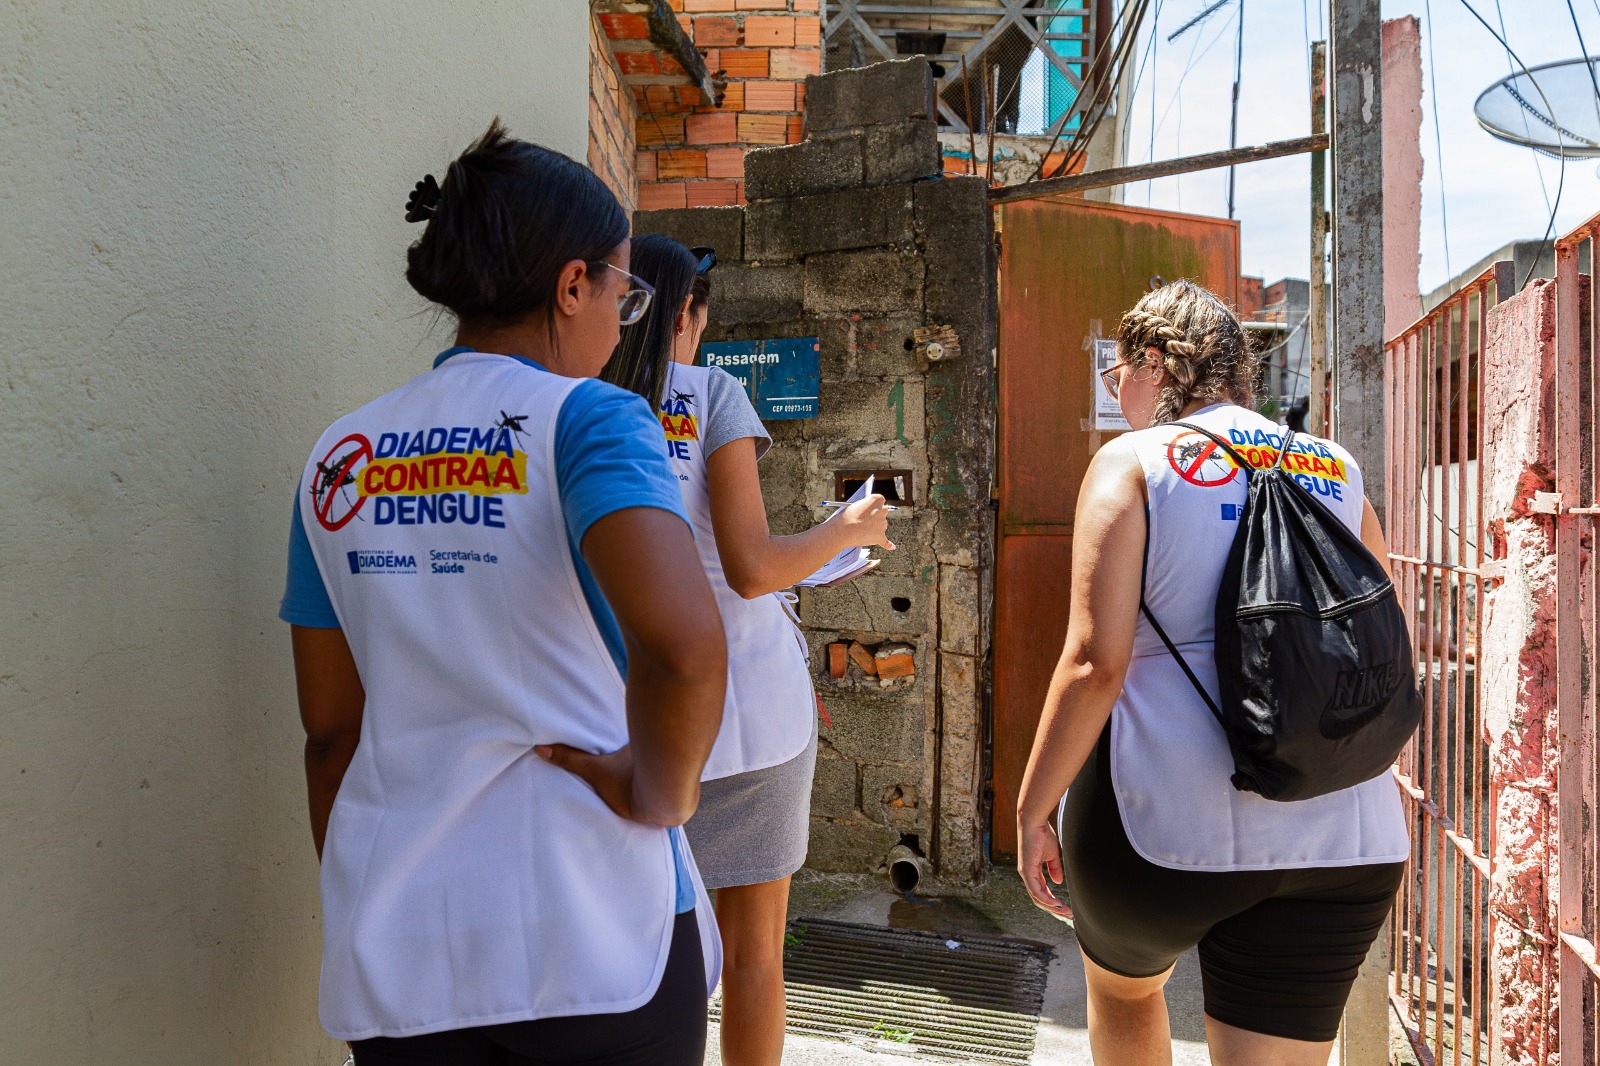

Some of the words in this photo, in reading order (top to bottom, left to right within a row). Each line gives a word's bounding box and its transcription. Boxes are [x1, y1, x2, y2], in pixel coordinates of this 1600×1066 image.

[706, 352, 780, 366] Passagem
[374, 426, 515, 459] DIADEMA
[364, 456, 491, 494] CONTRA
[374, 492, 506, 529] DENGUE
[359, 555, 417, 568] DIADEMA
[429, 549, 481, 562] Secretaria
[483, 552, 498, 564] de
[431, 561, 465, 574] Saúde
[1332, 660, 1396, 710] NIKE
